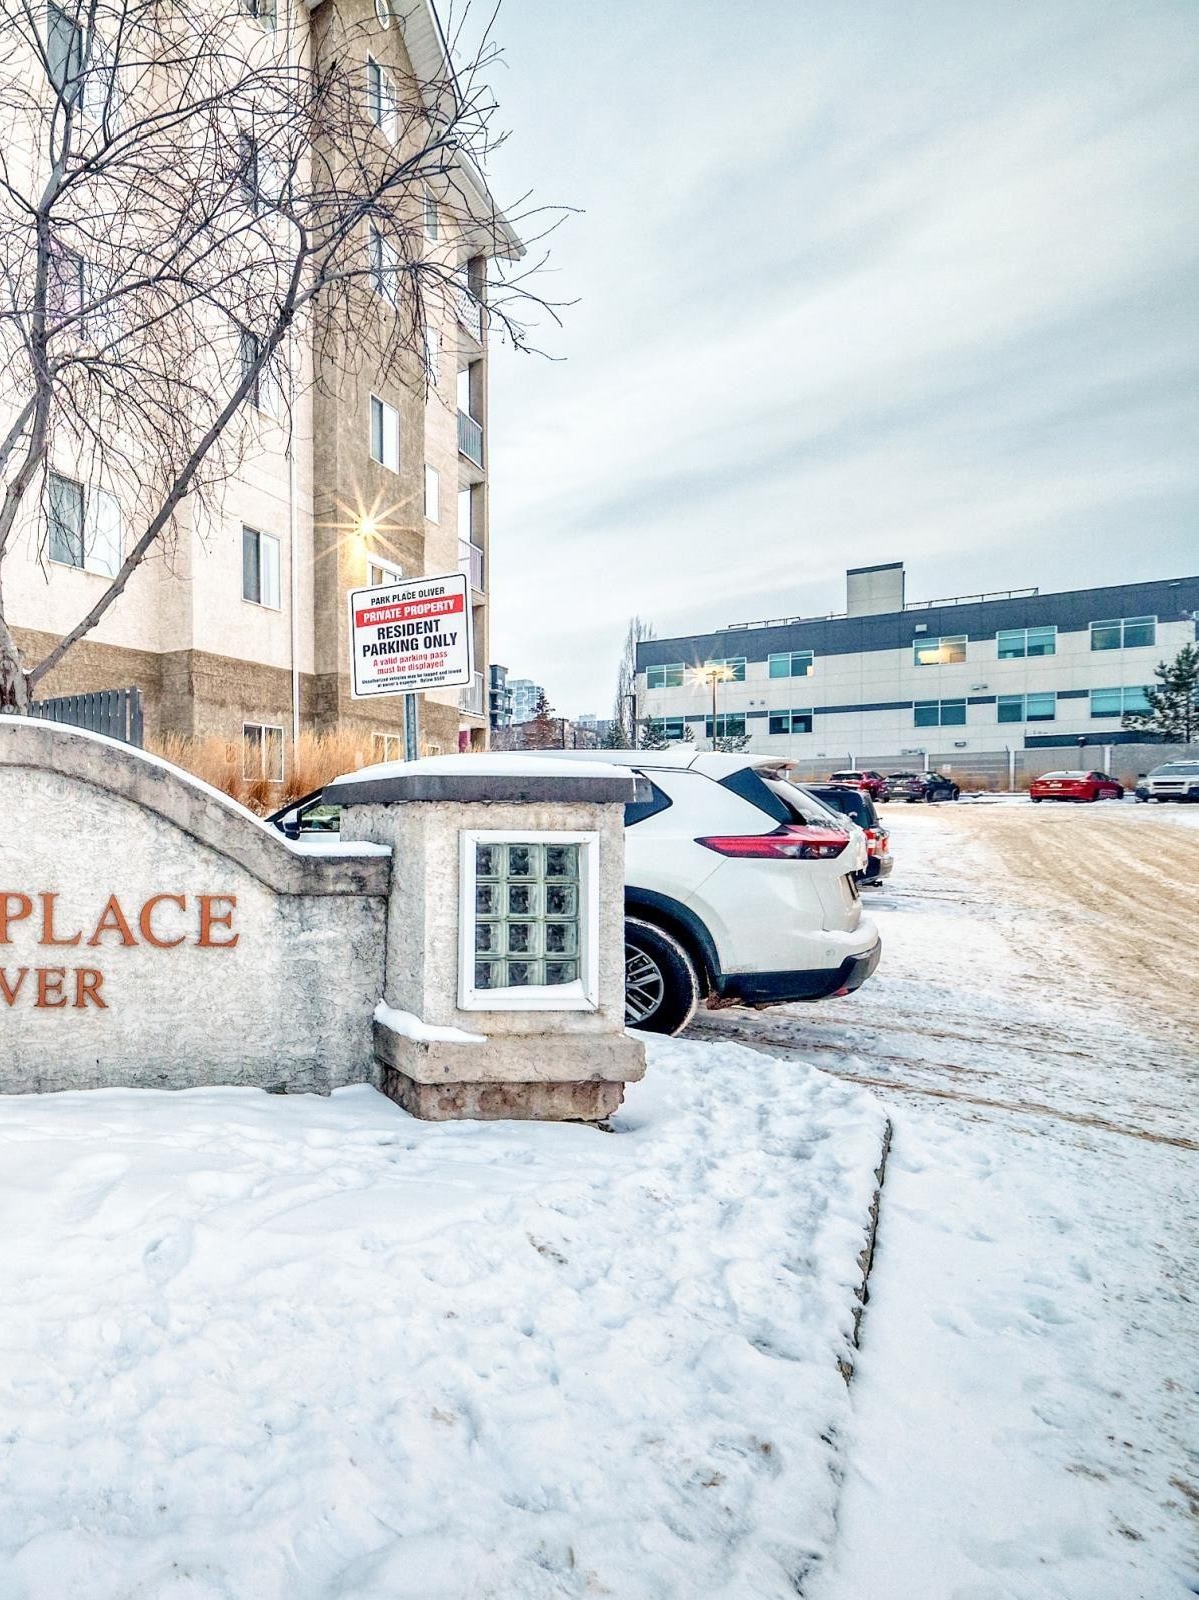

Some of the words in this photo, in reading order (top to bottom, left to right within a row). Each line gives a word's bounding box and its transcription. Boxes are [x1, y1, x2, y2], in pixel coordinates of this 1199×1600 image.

[371, 594, 391, 606] PARK
[392, 591, 416, 602] PLACE
[418, 587, 445, 599] OLIVER
[363, 609, 401, 623] PRIVATE
[404, 599, 455, 617] PROPERTY
[377, 619, 440, 640] RESIDENT
[362, 638, 419, 657] PARKING
[423, 632, 458, 649] ONLY
[373, 659, 378, 667] A
[380, 656, 398, 666] valid
[399, 653, 428, 665] parking
[430, 651, 448, 661] pass
[377, 666, 395, 675] must
[397, 664, 406, 673] be
[407, 660, 444, 672] displayed
